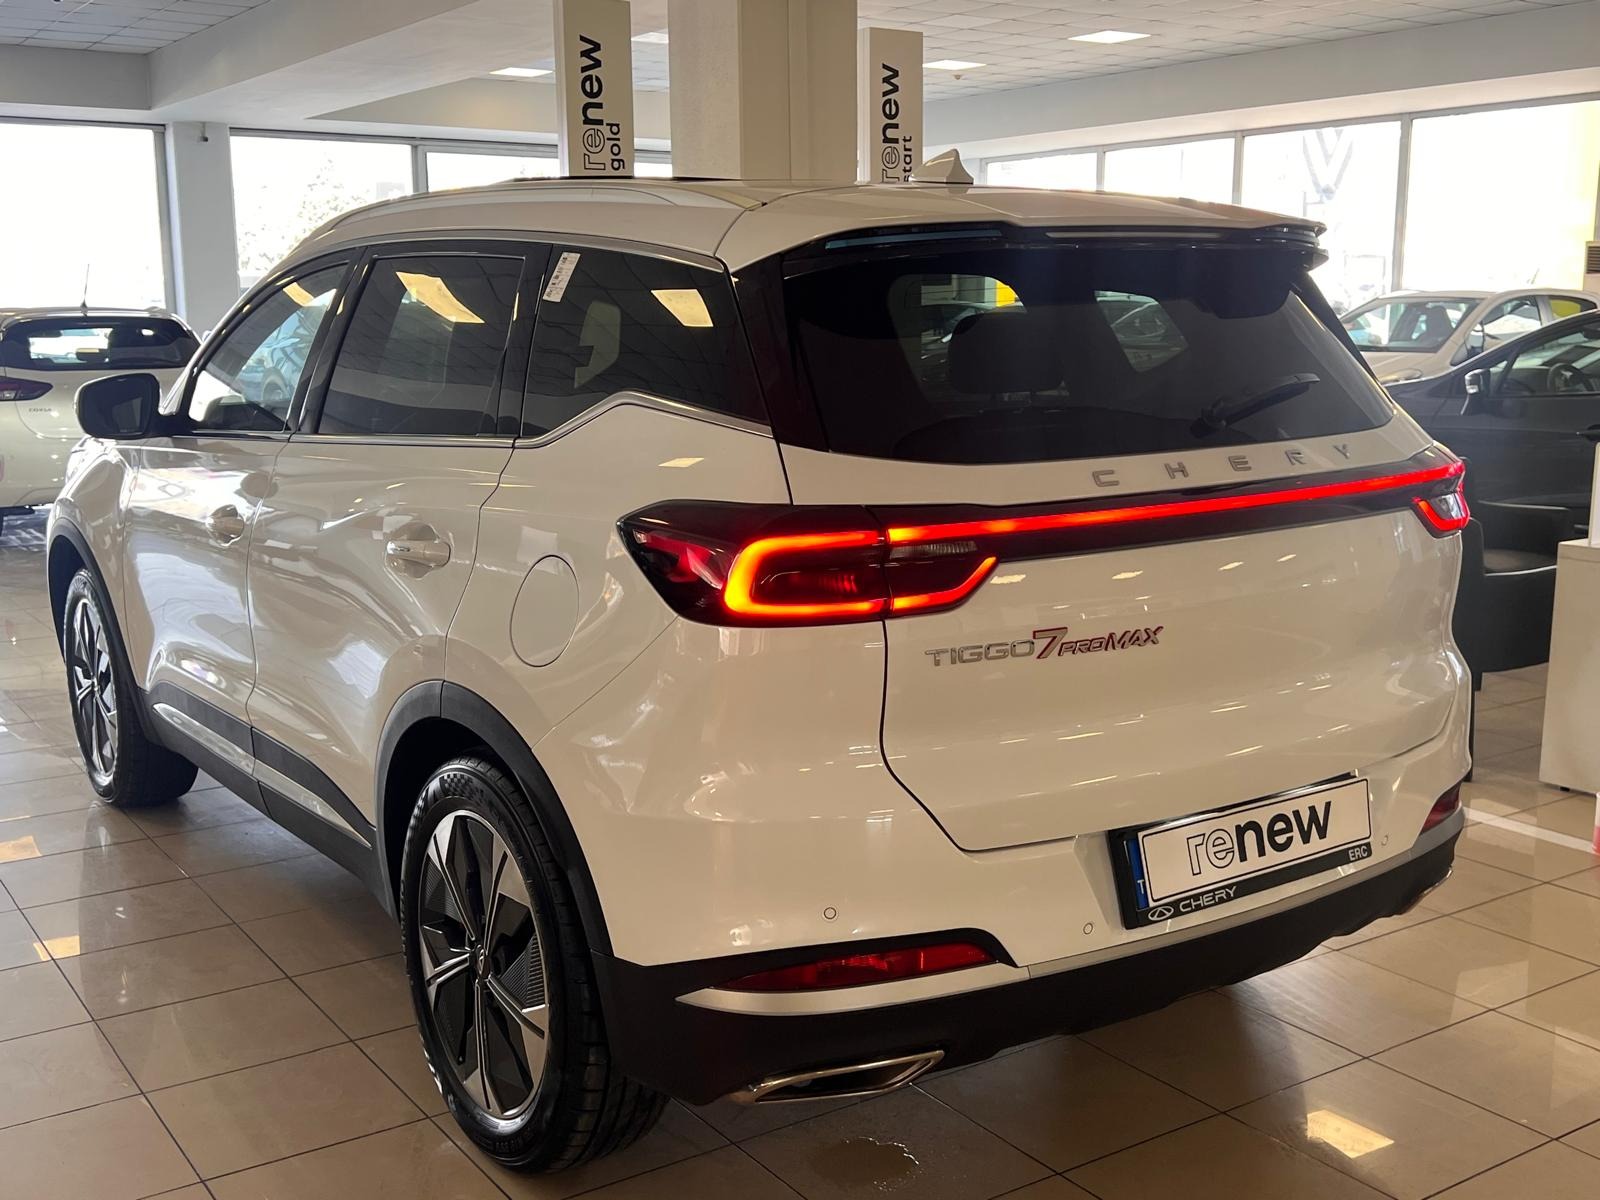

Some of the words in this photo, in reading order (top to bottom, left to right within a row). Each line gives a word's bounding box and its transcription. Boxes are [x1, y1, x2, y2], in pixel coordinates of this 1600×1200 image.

[579, 34, 606, 171] renew
[882, 63, 900, 182] renew
[606, 123, 625, 171] gold
[1092, 443, 1351, 487] CHERY
[1186, 801, 1332, 876] renew
[1349, 845, 1368, 860] ERC
[1179, 886, 1237, 912] CHERY
